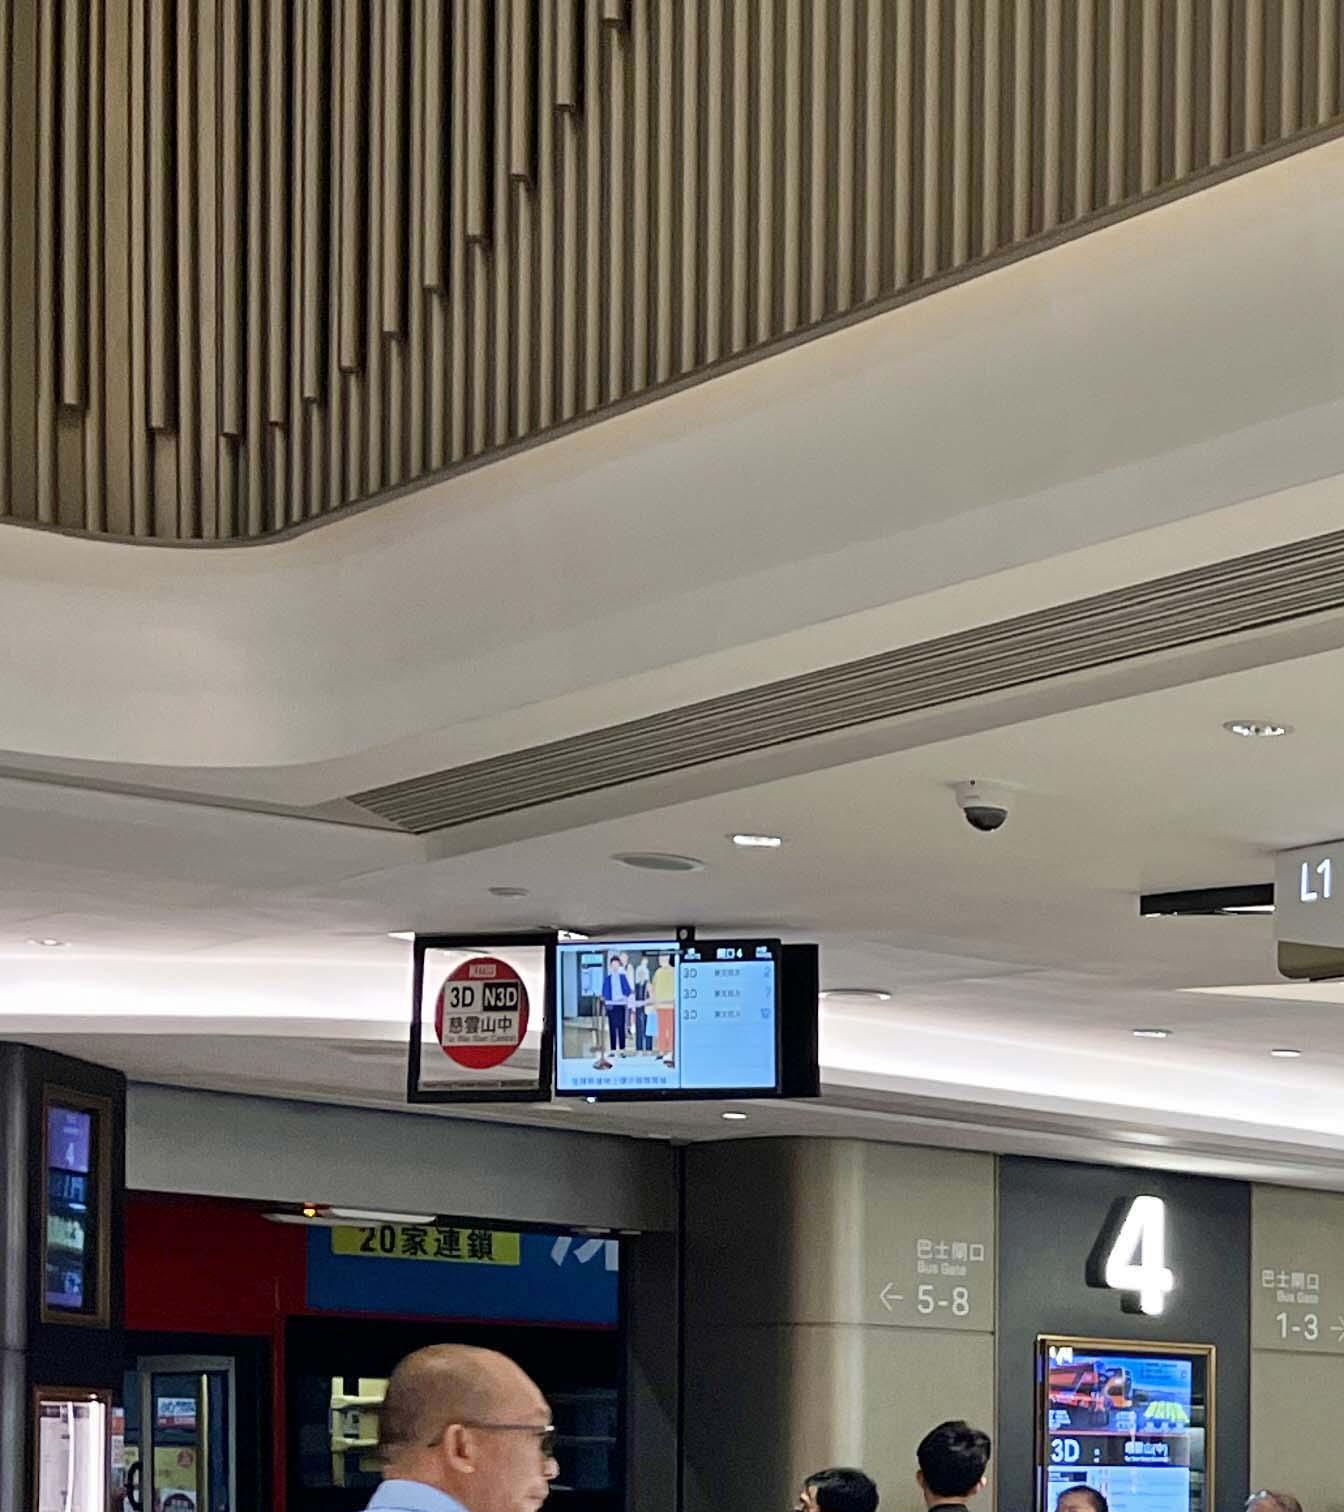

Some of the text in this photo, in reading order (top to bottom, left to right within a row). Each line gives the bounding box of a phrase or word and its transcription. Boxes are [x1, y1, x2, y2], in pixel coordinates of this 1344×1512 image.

[1300, 858, 1331, 902] L1
[450, 986, 475, 1008] 3D
[484, 986, 518, 1007] N3D
[448, 1015, 512, 1034] 慈雲山中
[358, 1224, 495, 1261] 20家連鎖
[917, 1239, 985, 1262] 巴士閘口
[1105, 1195, 1175, 1316] 4
[917, 1260, 967, 1276] Bus Gate
[1262, 1269, 1320, 1290] 巴士閘口
[917, 1284, 970, 1316] 5-8
[1276, 1290, 1319, 1304] Bus Gate
[1276, 1311, 1319, 1341] 1-3
[1050, 1438, 1080, 1463] 3D
